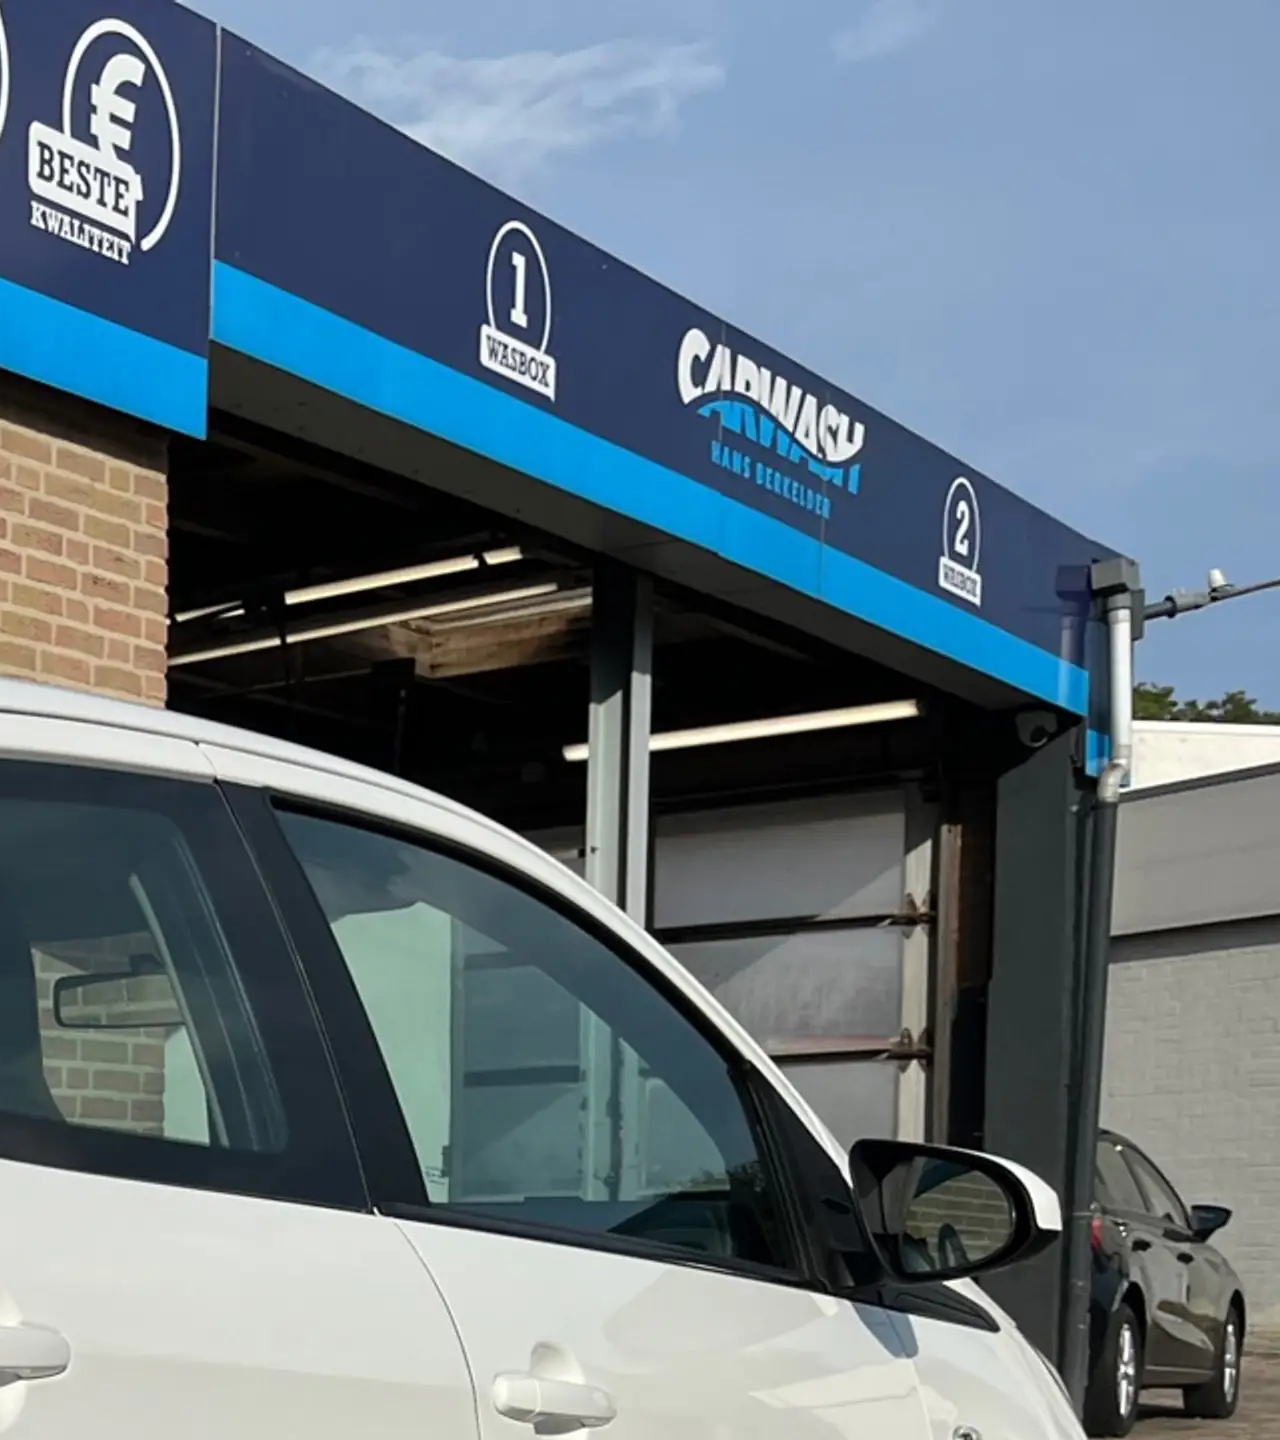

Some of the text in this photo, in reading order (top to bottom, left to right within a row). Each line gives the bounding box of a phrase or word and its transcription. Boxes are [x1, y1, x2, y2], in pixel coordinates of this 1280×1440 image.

[36, 140, 130, 218] BESTE
[29, 199, 132, 266] KWALITEIT
[510, 251, 528, 329] 1
[485, 333, 551, 389] WASBOX
[677, 327, 865, 495] CARWASH
[711, 440, 751, 479] HANS
[954, 500, 970, 557] 2
